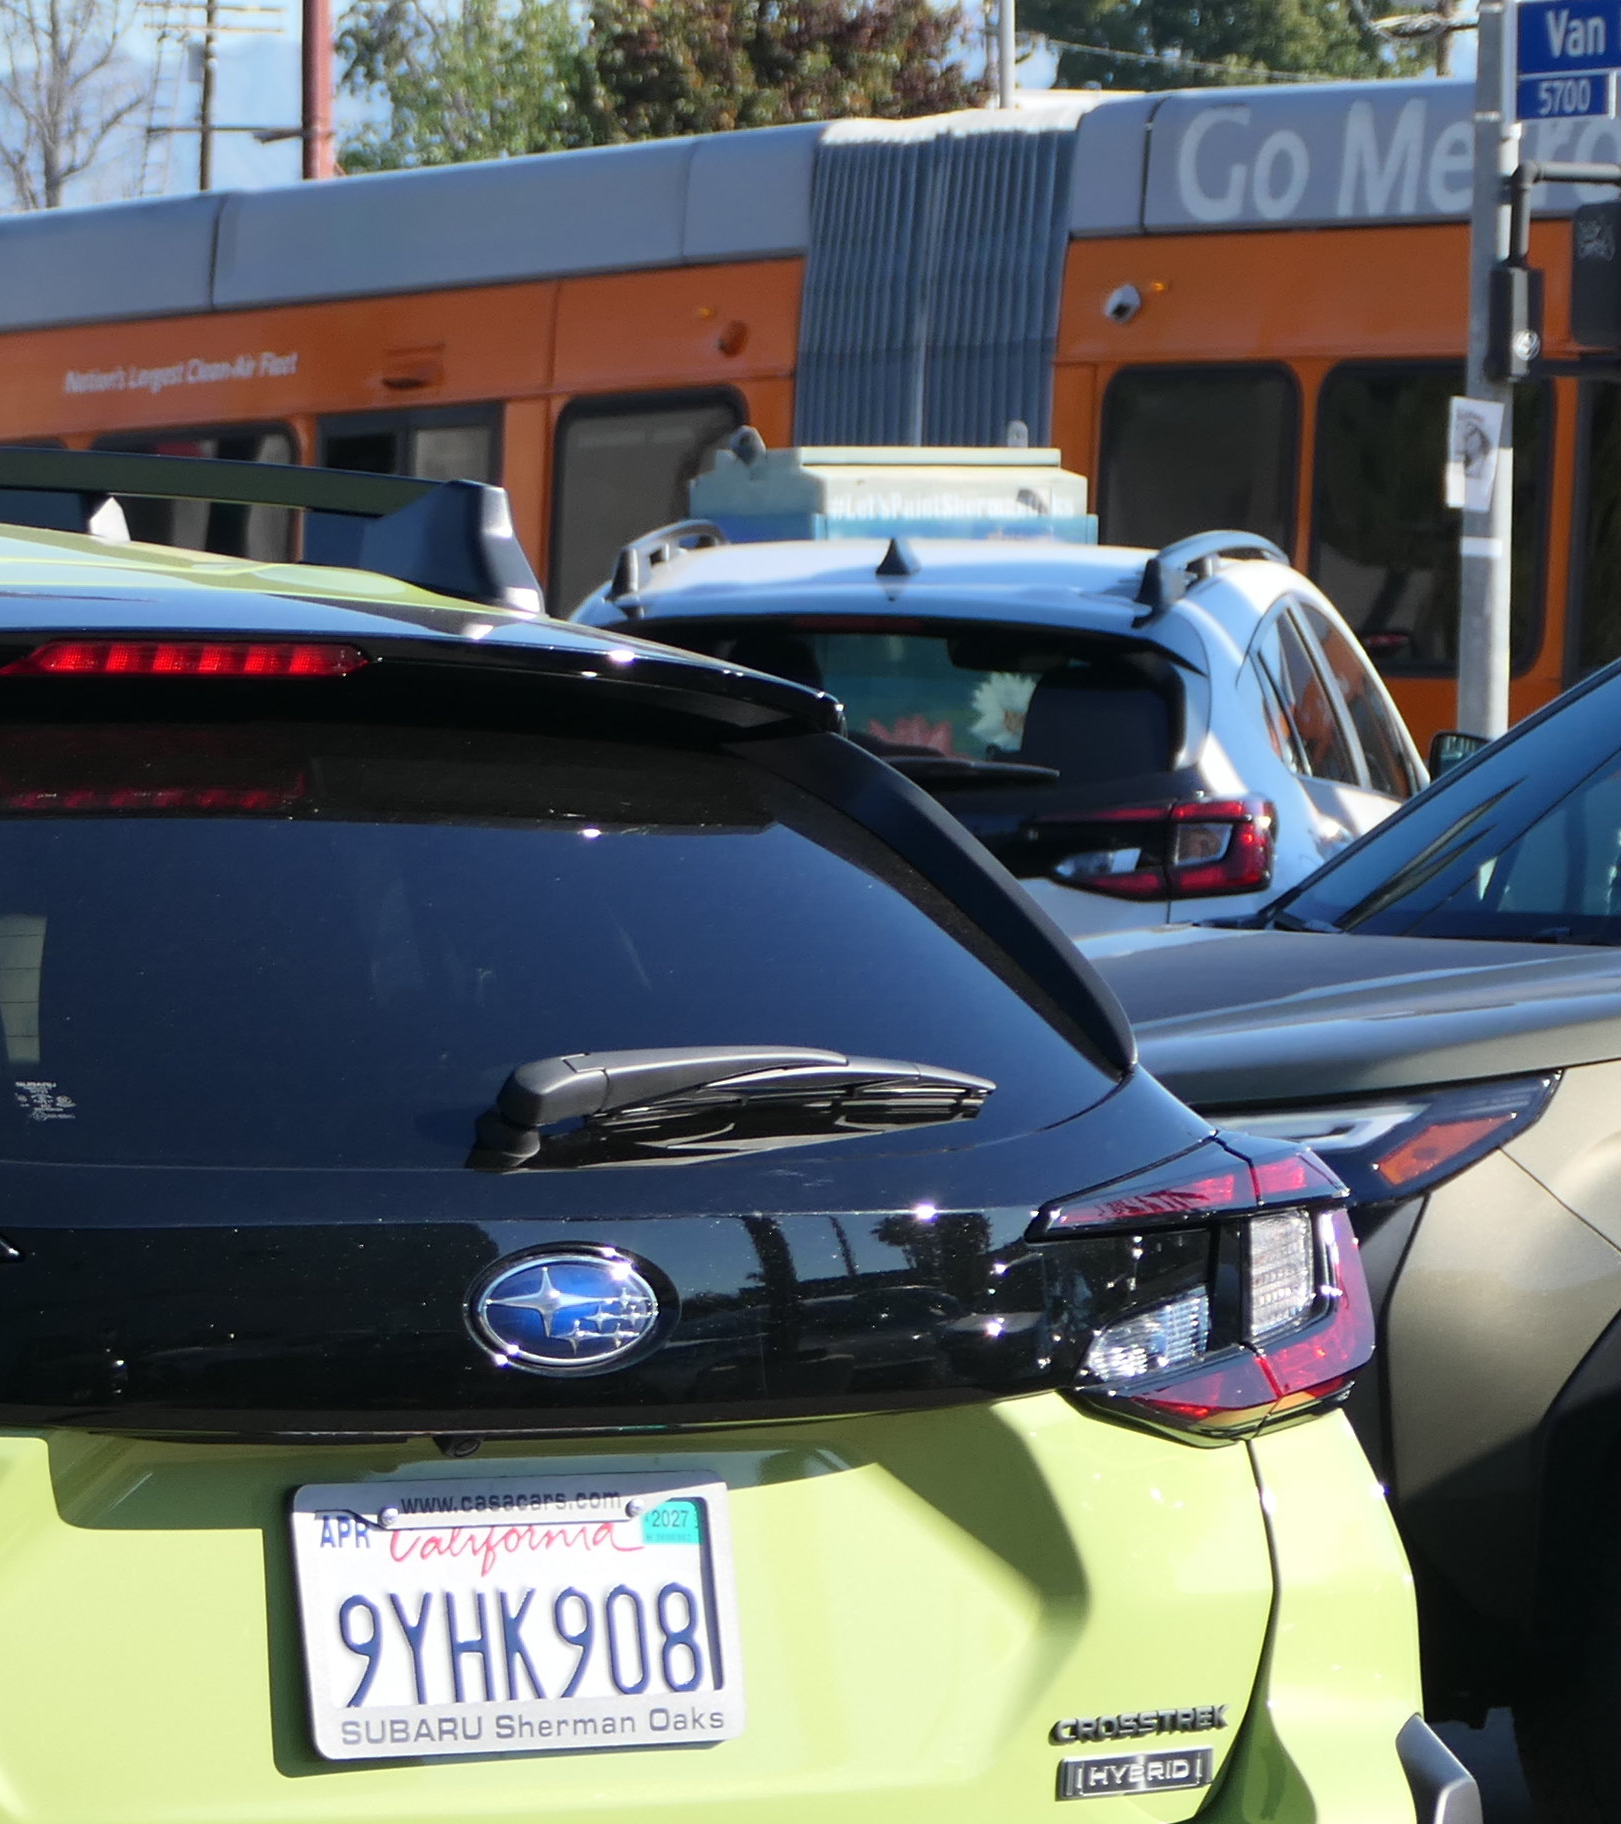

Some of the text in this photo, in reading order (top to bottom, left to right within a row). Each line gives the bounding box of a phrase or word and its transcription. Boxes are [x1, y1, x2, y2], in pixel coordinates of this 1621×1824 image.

[1545, 9, 1605, 58] Van
[1538, 78, 1592, 116] 5700
[1177, 96, 1621, 222] Go Mero
[128, 362, 185, 394] Largest
[260, 351, 299, 377] Fleet
[401, 1489, 622, 1514] www.casacars.com
[320, 1509, 689, 1578] APR California 2027
[339, 1582, 703, 1708] 9YHK908
[341, 1706, 725, 1746] SUBARU Sherman Oaks
[1056, 1704, 1230, 1742] CROSSTREK
[1088, 1758, 1190, 1788] HYBRID
